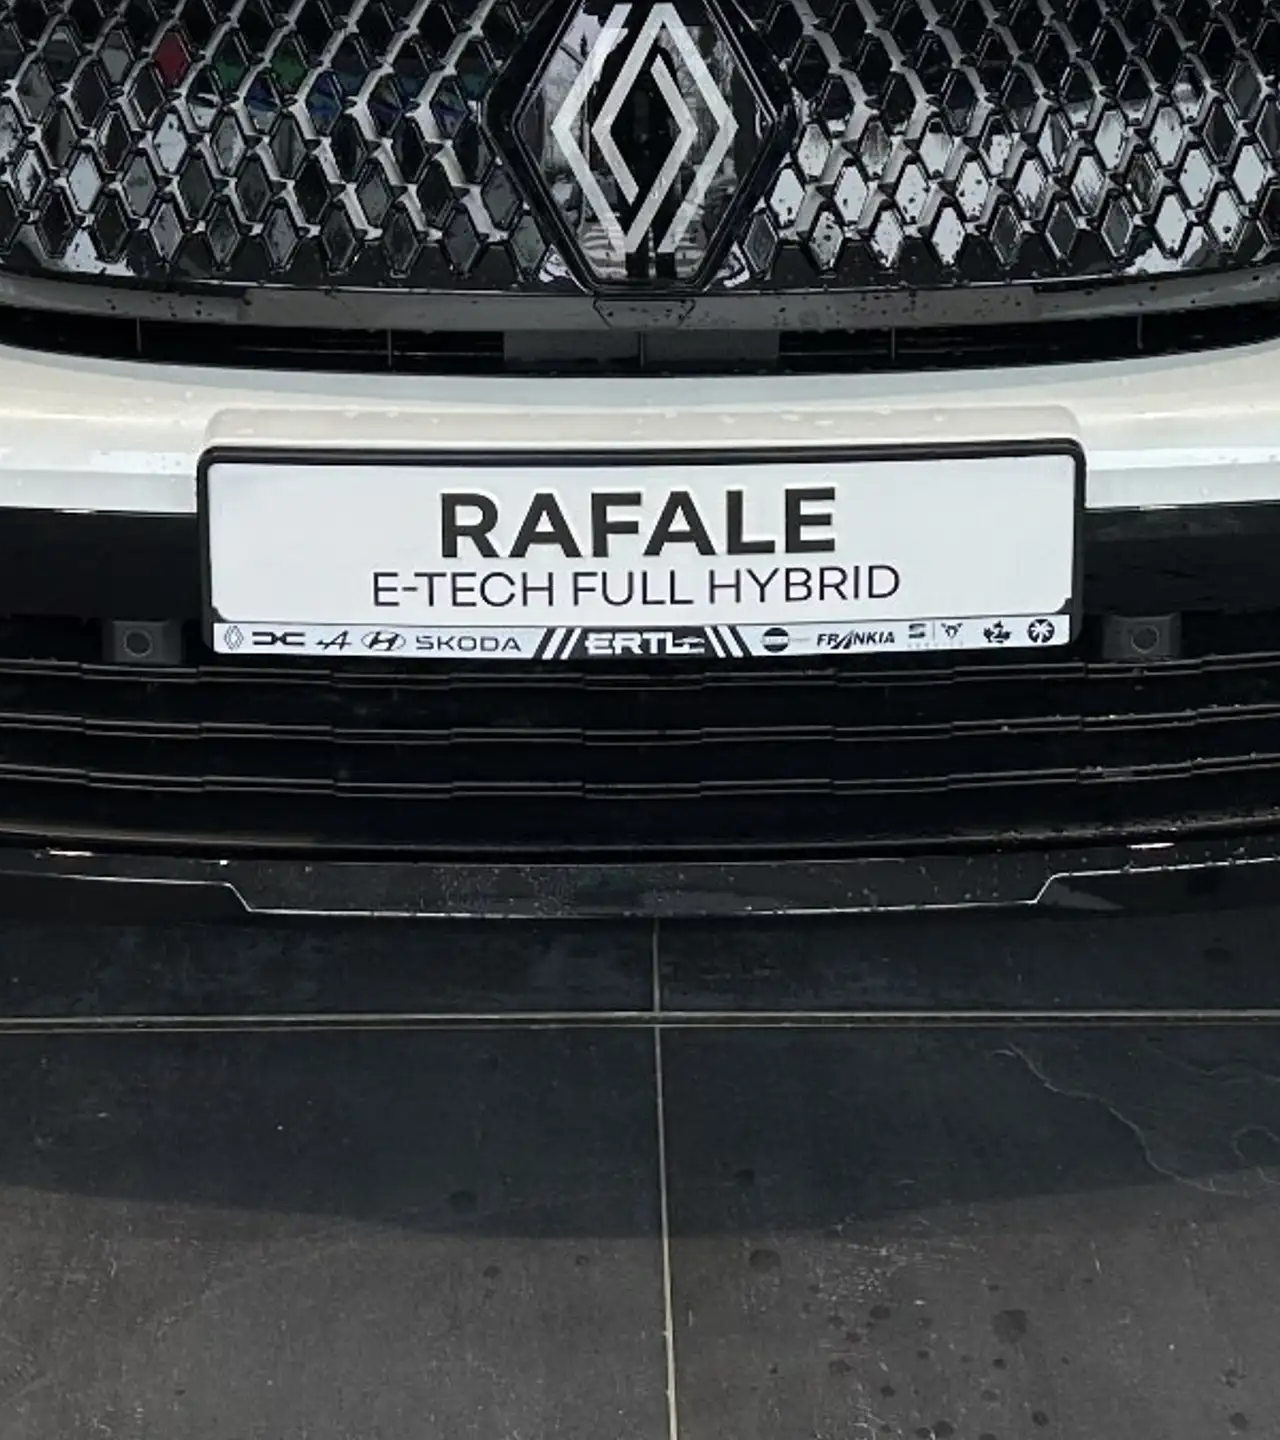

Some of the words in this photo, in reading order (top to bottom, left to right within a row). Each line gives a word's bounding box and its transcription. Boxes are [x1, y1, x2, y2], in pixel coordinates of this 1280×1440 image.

[440, 486, 836, 559] RAFALE
[372, 571, 555, 607] E-TECH
[572, 569, 695, 606] FULL
[708, 564, 901, 604] HYBRID
[816, 629, 896, 650] FRANKIA
